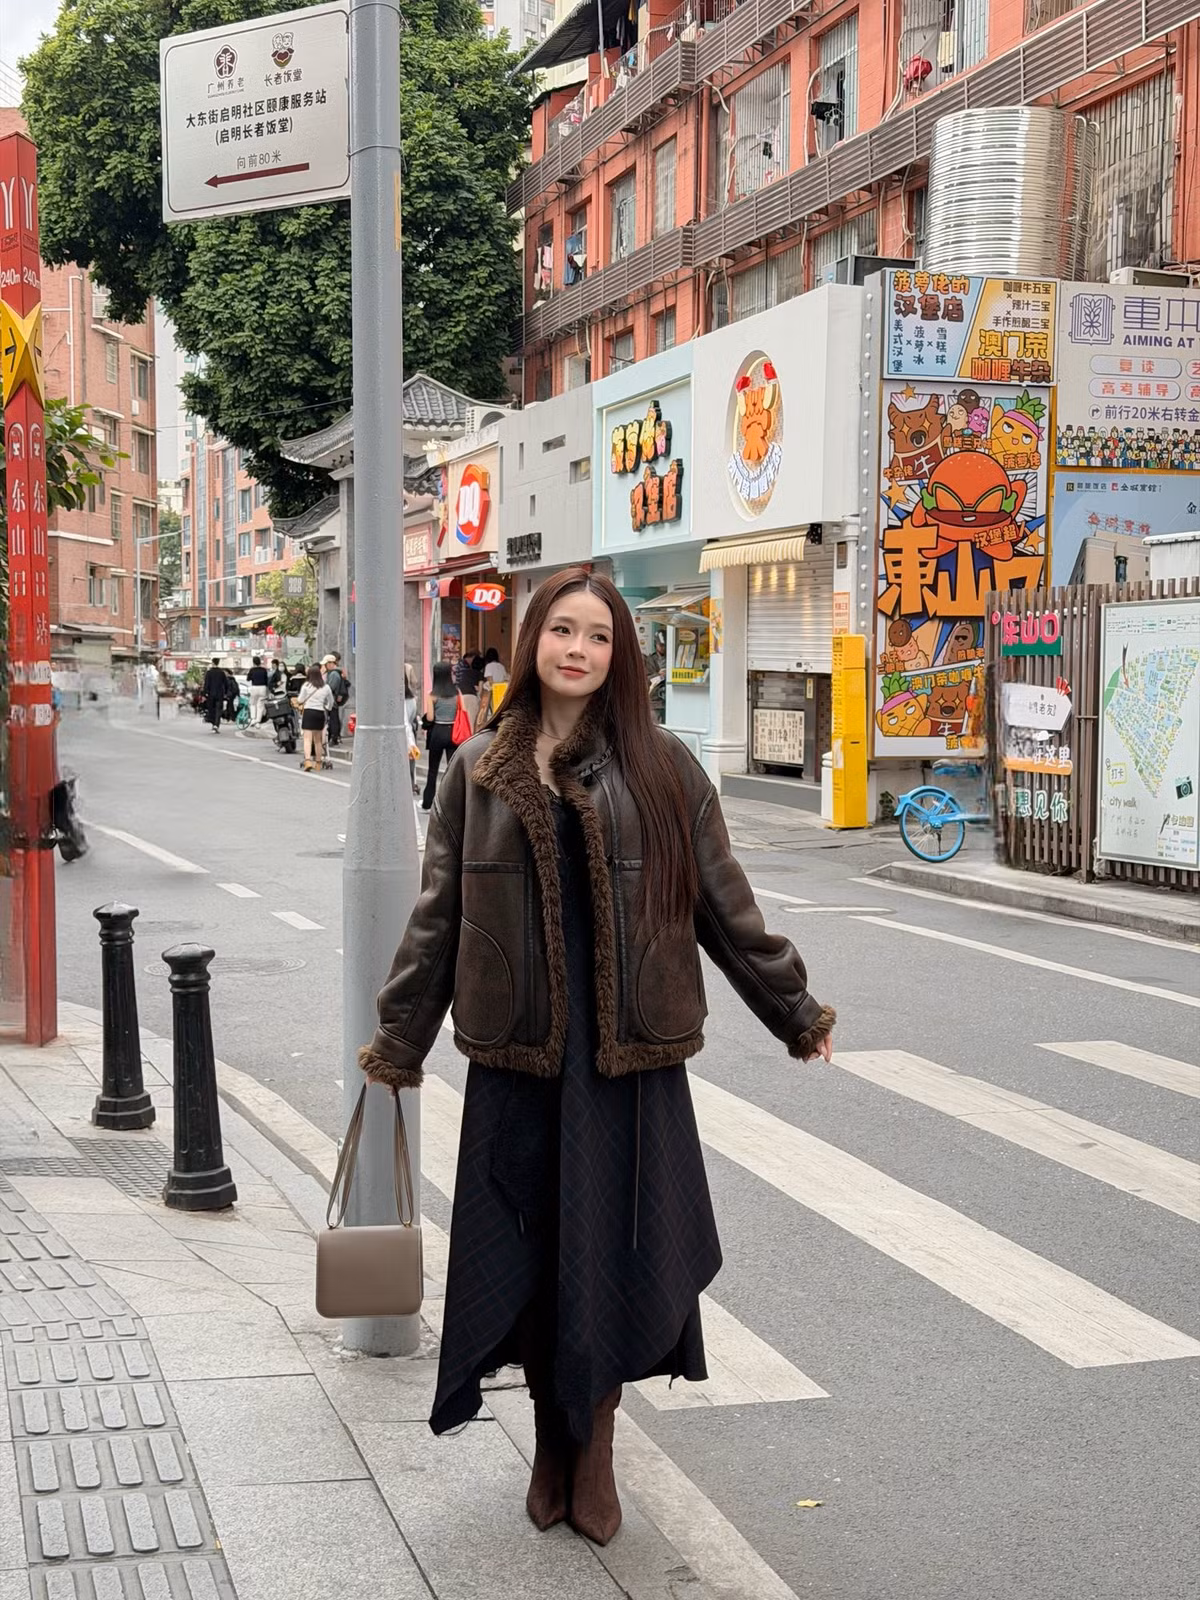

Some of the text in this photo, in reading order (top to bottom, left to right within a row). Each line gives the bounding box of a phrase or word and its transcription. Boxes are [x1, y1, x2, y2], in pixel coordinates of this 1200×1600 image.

[264, 68, 303, 87] 长者饭堂
[186, 89, 327, 128] 大东街启明社区颐康服务站
[237, 149, 281, 170] 向前80米
[893, 270, 970, 296] 菠萝佬的
[894, 294, 964, 323] 汉堡店
[892, 318, 904, 373] 美式汉堡
[935, 326, 947, 366] 雪糕球
[978, 329, 1048, 359] 澳门荣
[1123, 334, 1195, 348] AIMING AT
[971, 357, 1051, 383] 咖喱牛杂
[1102, 381, 1169, 397] 高考辅导
[1003, 451, 1042, 470] 菠萝佬
[974, 520, 1030, 548] 汉堡超人
[473, 588, 501, 606] DQ
[1002, 611, 1060, 646] 东山口
